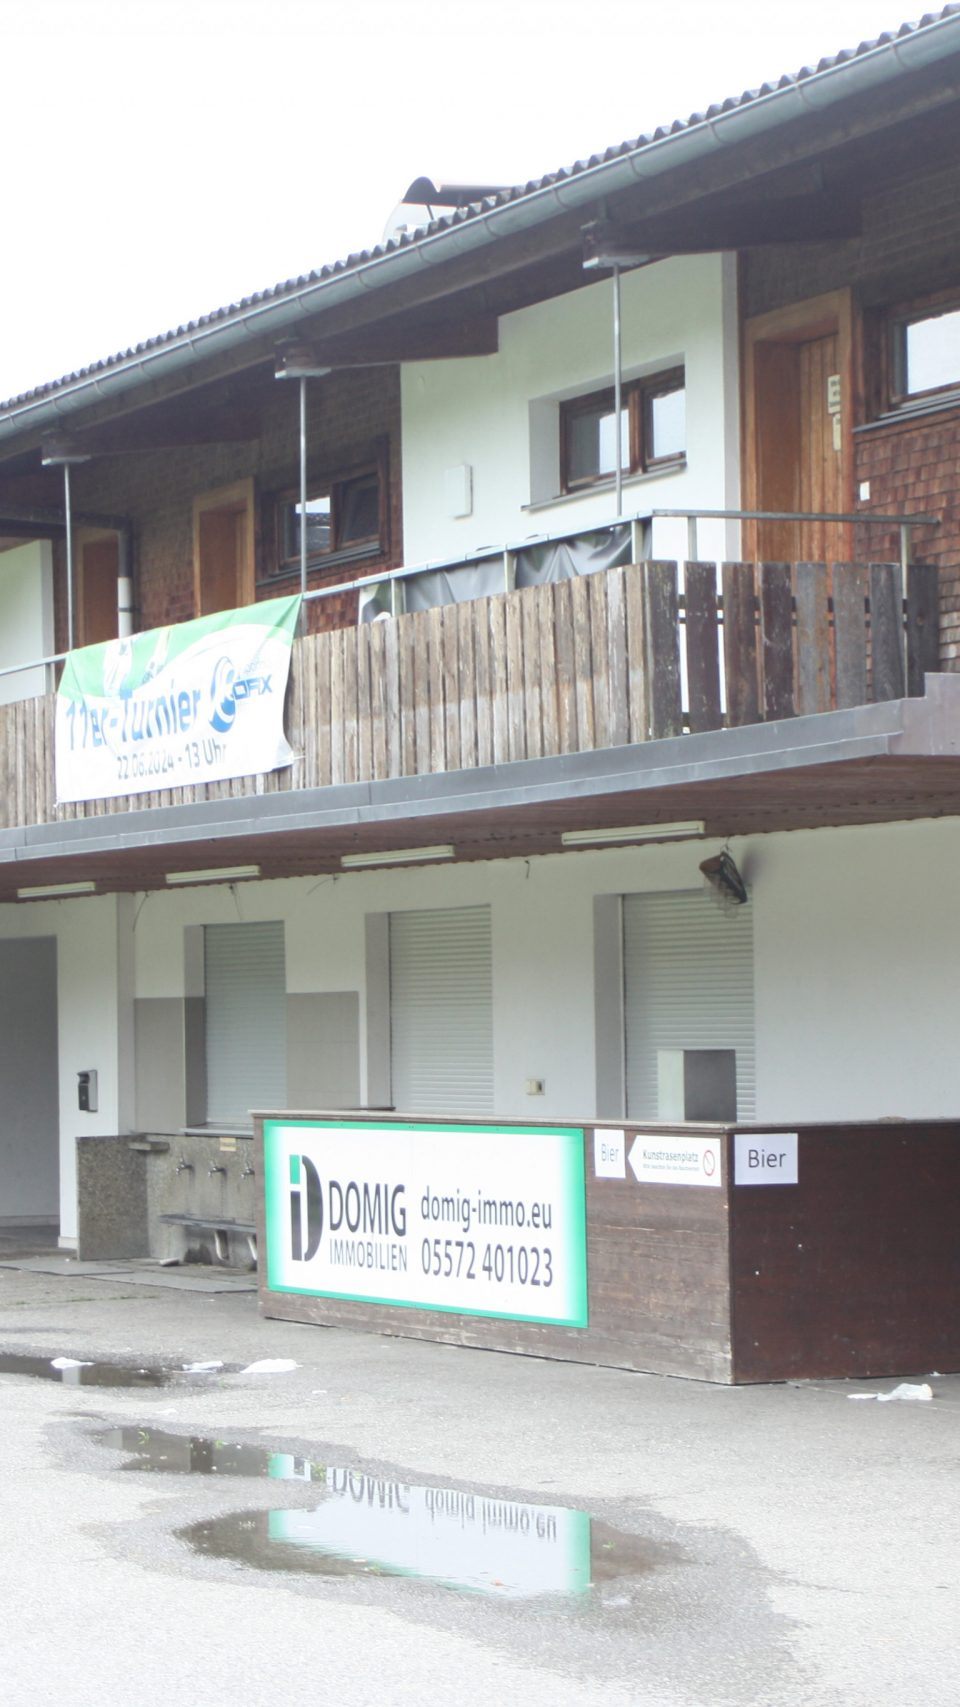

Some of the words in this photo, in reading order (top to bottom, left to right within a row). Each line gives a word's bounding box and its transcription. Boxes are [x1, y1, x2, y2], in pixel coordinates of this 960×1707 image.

[66, 679, 201, 750] 11er-Turnier
[185, 741, 199, 769] 13
[203, 738, 227, 766] Uhr
[601, 1143, 619, 1163] Bier
[642, 1149, 699, 1164] Kunstrasenplatz
[747, 1148, 787, 1168] Bier
[328, 1180, 407, 1237] DOMIG
[420, 1185, 552, 1233] domig-immo.eu
[329, 1238, 408, 1272] IMMOBILIEN
[421, 1237, 476, 1279] 05572
[481, 1243, 553, 1288] 401023
